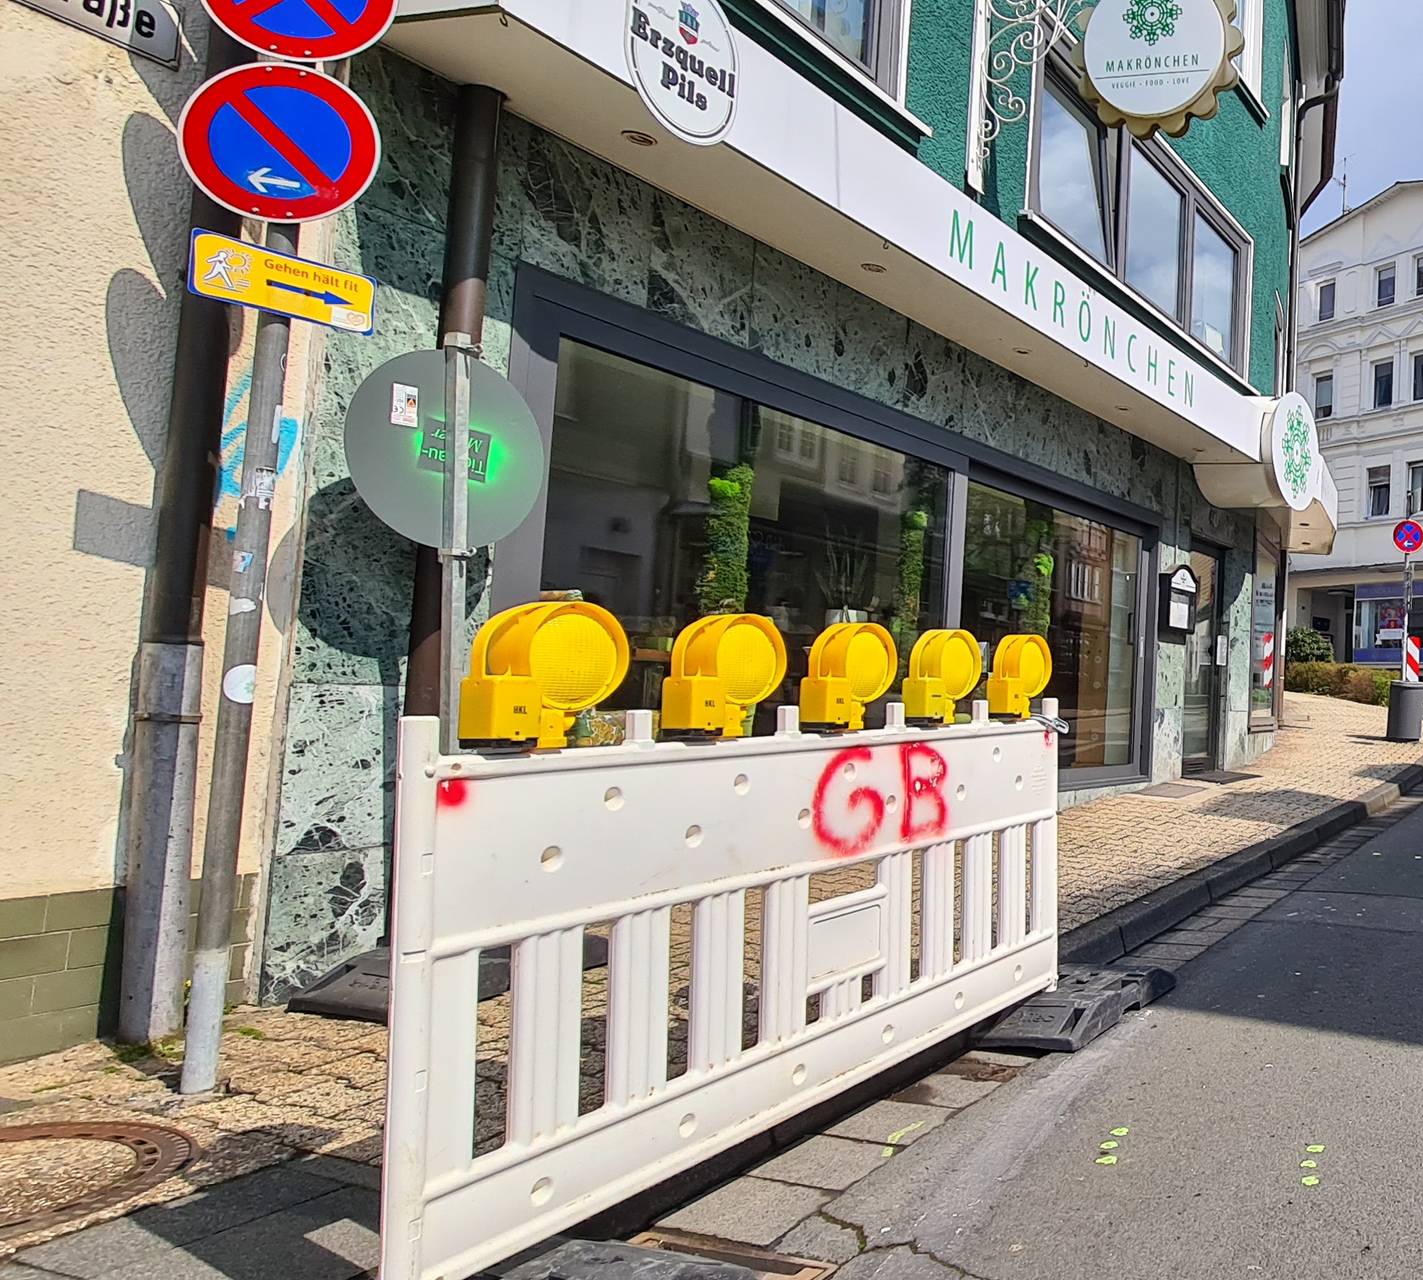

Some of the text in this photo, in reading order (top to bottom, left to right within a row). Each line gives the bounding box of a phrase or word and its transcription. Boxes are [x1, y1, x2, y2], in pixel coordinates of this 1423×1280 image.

[64, 0, 156, 38] aße
[631, 5, 735, 98] Erzquell
[1105, 53, 1200, 73] MAKRÖNCHEN
[661, 61, 708, 111] Pils
[1112, 77, 1190, 89] VEGGIE FOOD LOVE
[264, 258, 359, 293] Gehen hält fit
[949, 208, 1194, 408] MAKRÖNCHEN
[812, 742, 948, 857] GB
